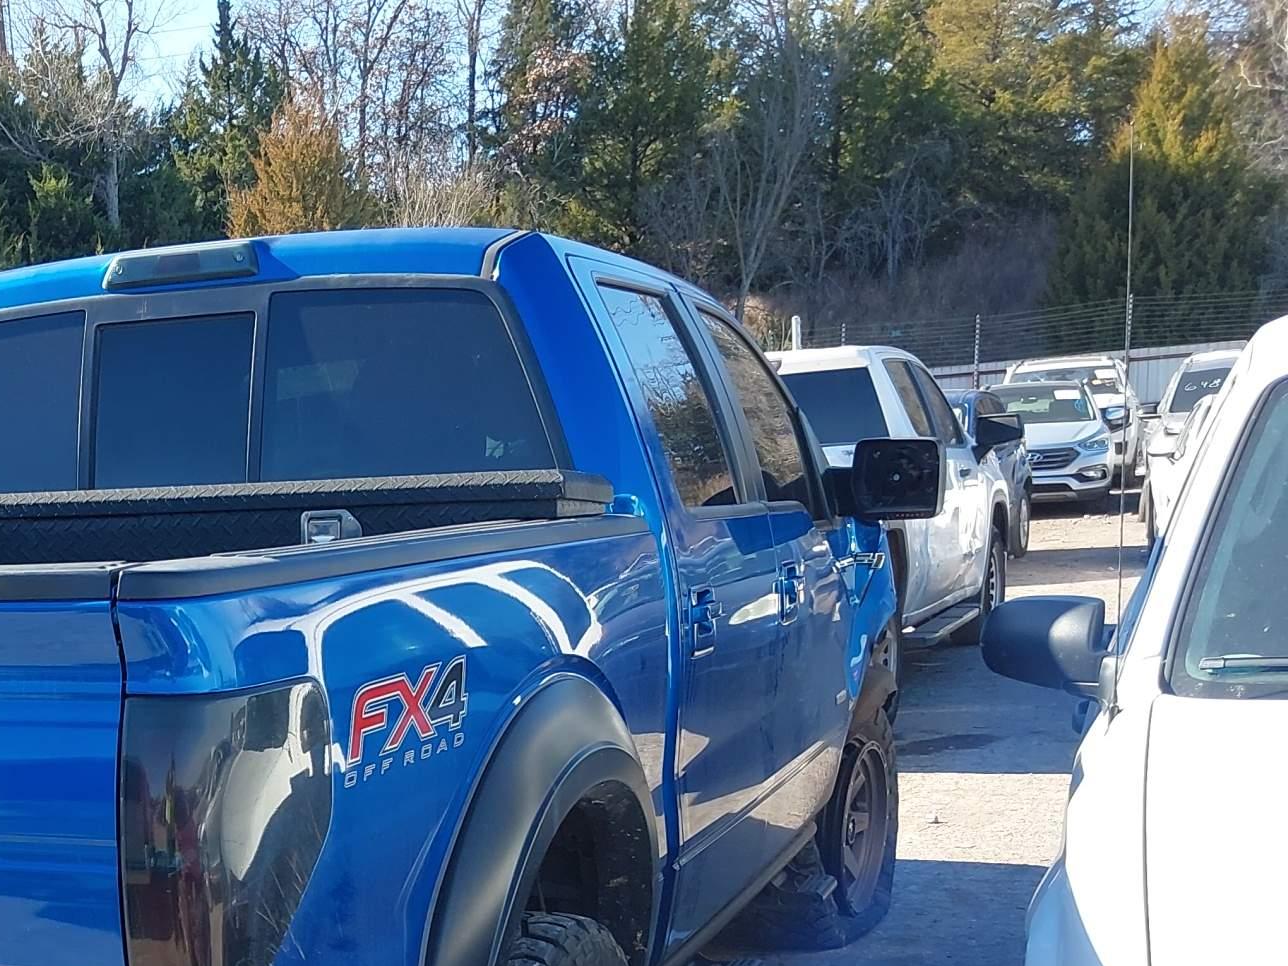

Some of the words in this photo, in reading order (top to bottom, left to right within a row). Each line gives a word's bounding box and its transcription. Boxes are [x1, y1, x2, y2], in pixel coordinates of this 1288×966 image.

[346, 655, 469, 768] FX4
[343, 757, 394, 788] OFF
[403, 732, 465, 767] ROAD
